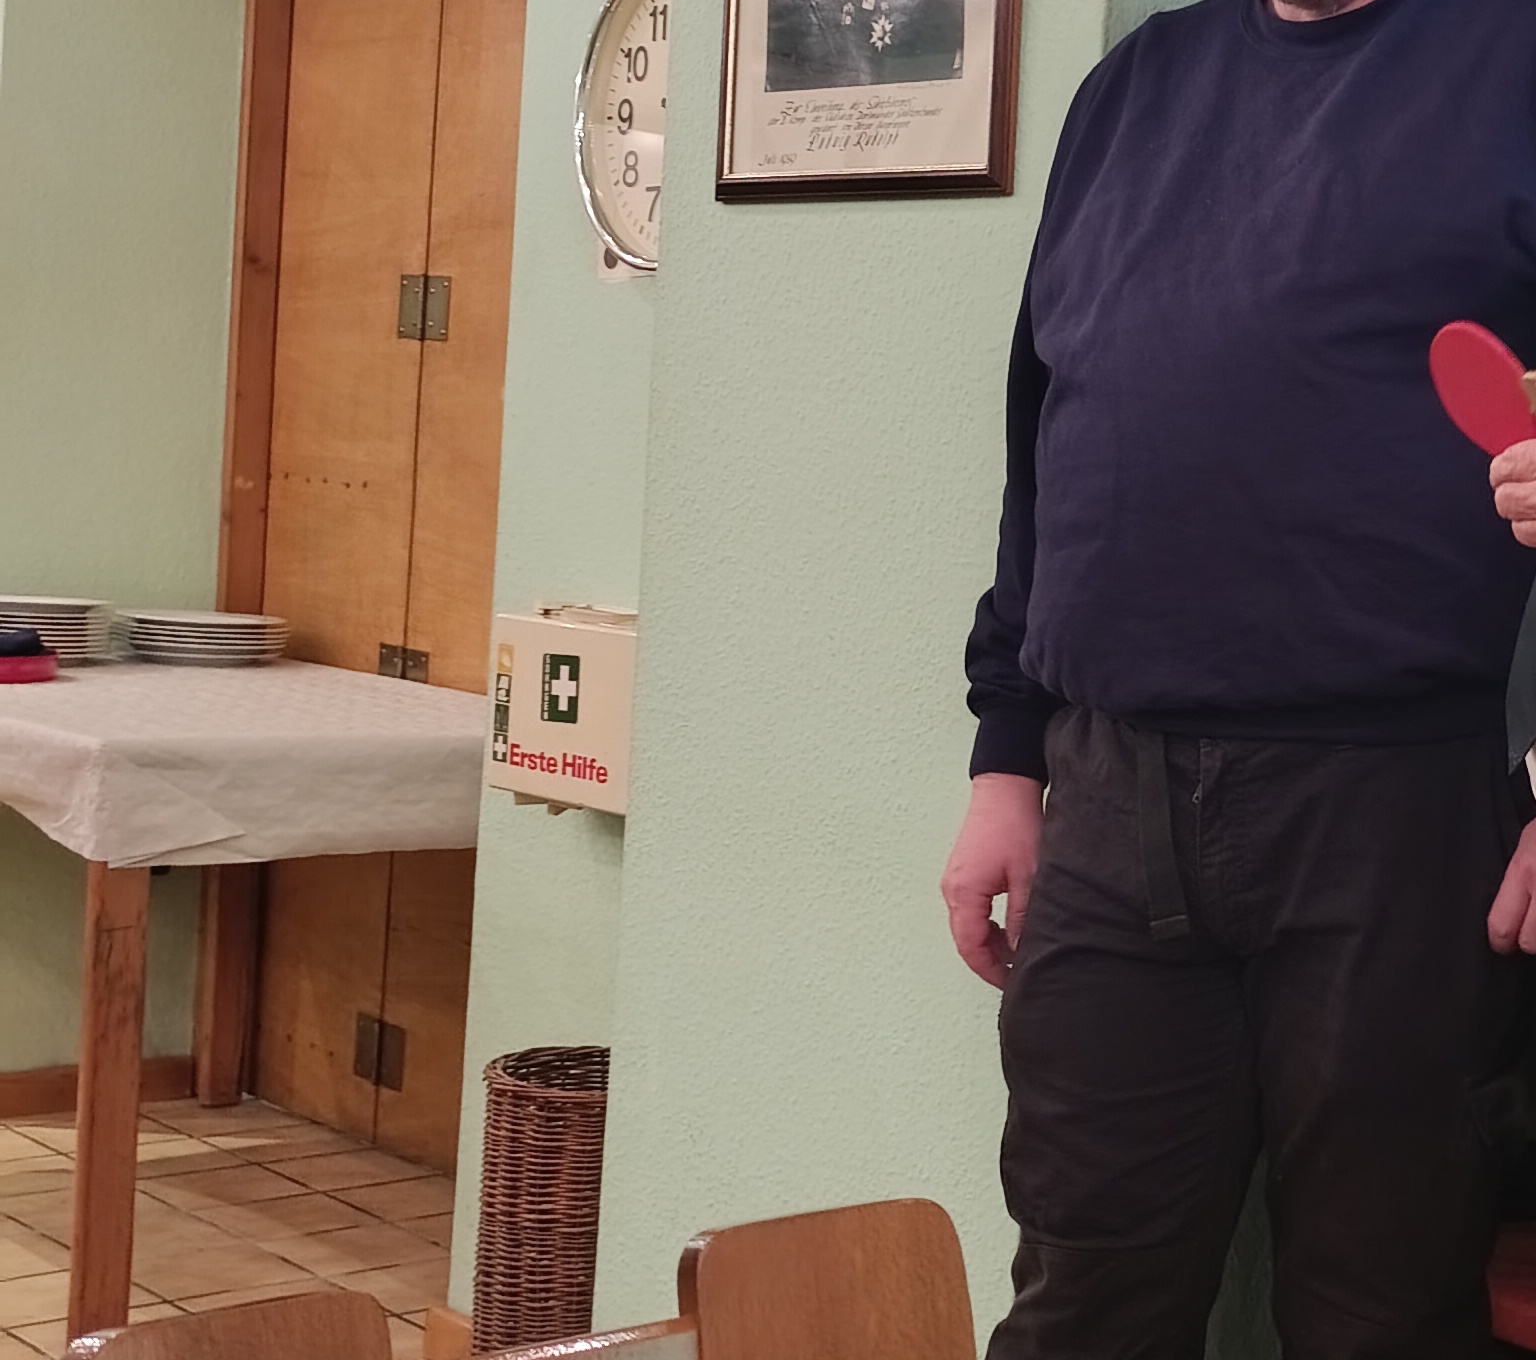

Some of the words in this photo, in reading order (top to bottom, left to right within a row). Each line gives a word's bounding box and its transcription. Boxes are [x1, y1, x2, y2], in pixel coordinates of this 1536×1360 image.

[649, 3, 668, 42] 11
[623, 45, 649, 83] 10
[617, 98, 634, 136] 9
[622, 150, 639, 188] 8
[645, 185, 661, 222] 7
[509, 742, 558, 774] Erste
[561, 752, 608, 784] Hilfe
